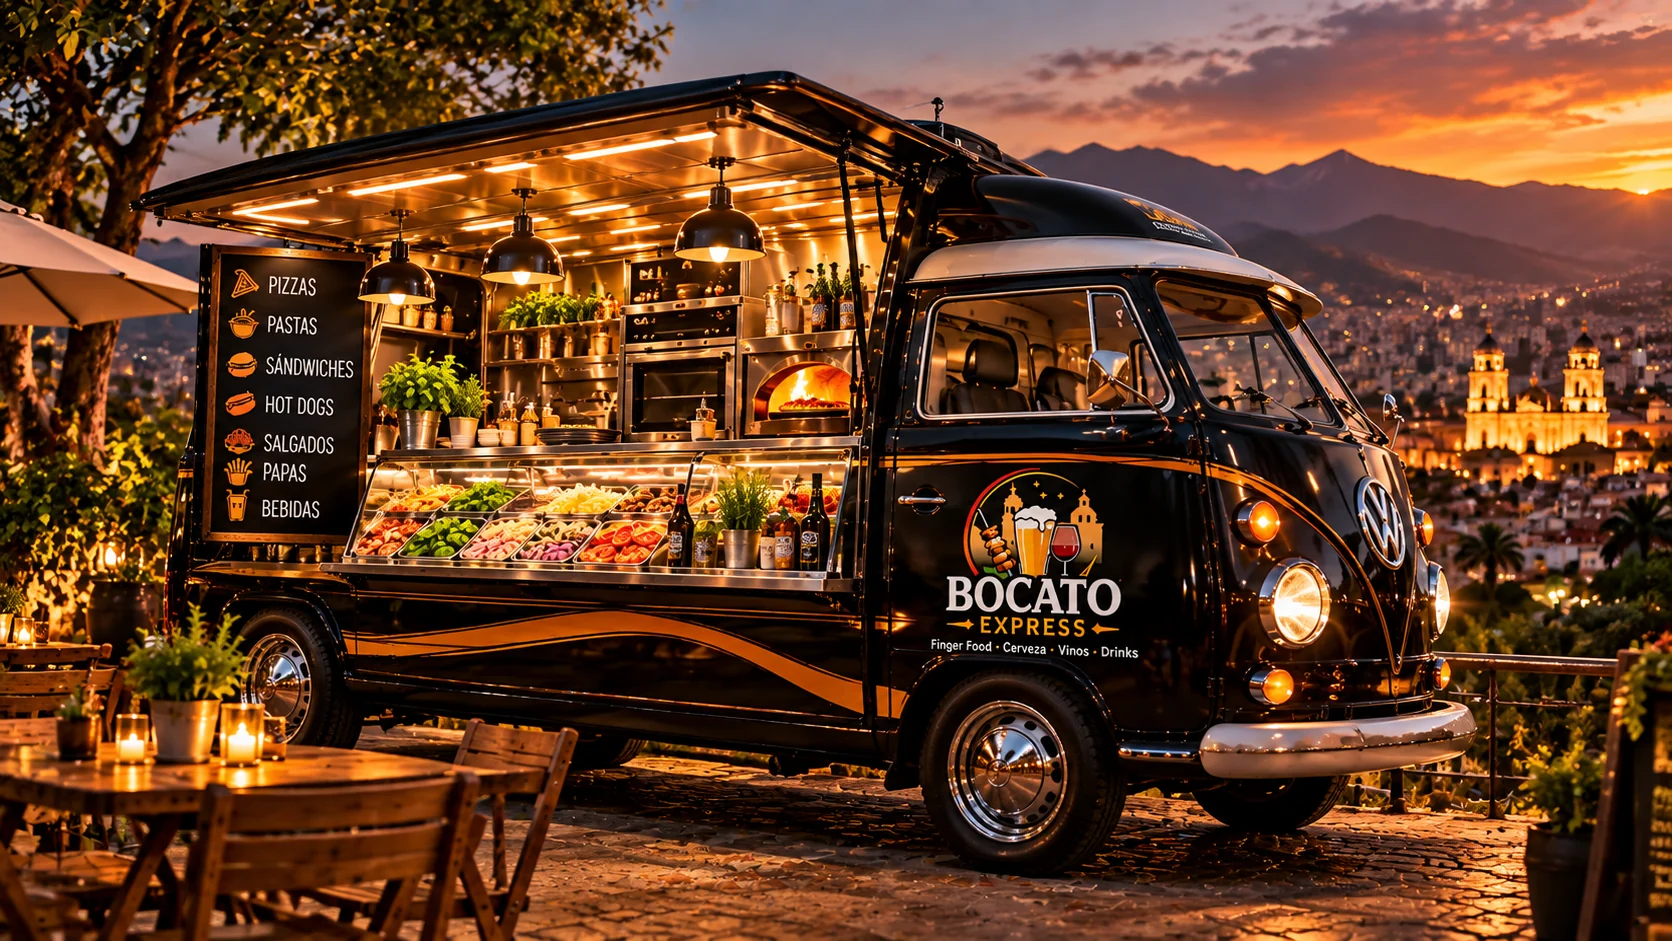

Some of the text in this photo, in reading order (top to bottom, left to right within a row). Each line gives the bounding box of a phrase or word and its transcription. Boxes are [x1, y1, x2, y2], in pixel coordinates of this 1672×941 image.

[268, 276, 317, 296] PIZZAS
[267, 316, 318, 335] PASTAS
[265, 354, 354, 378] SÁNDWICHES
[265, 396, 334, 416] HOT DOGS
[263, 434, 334, 454] SALGADOS
[263, 463, 307, 482] PAPAS
[261, 500, 320, 518] BEBIDAS
[1360, 482, 1402, 561] VW
[946, 576, 1122, 616] BOCATO
[980, 616, 1085, 637] EXPRESS
[930, 639, 1139, 659] Finger Food Cerveza Vinos Drinks
